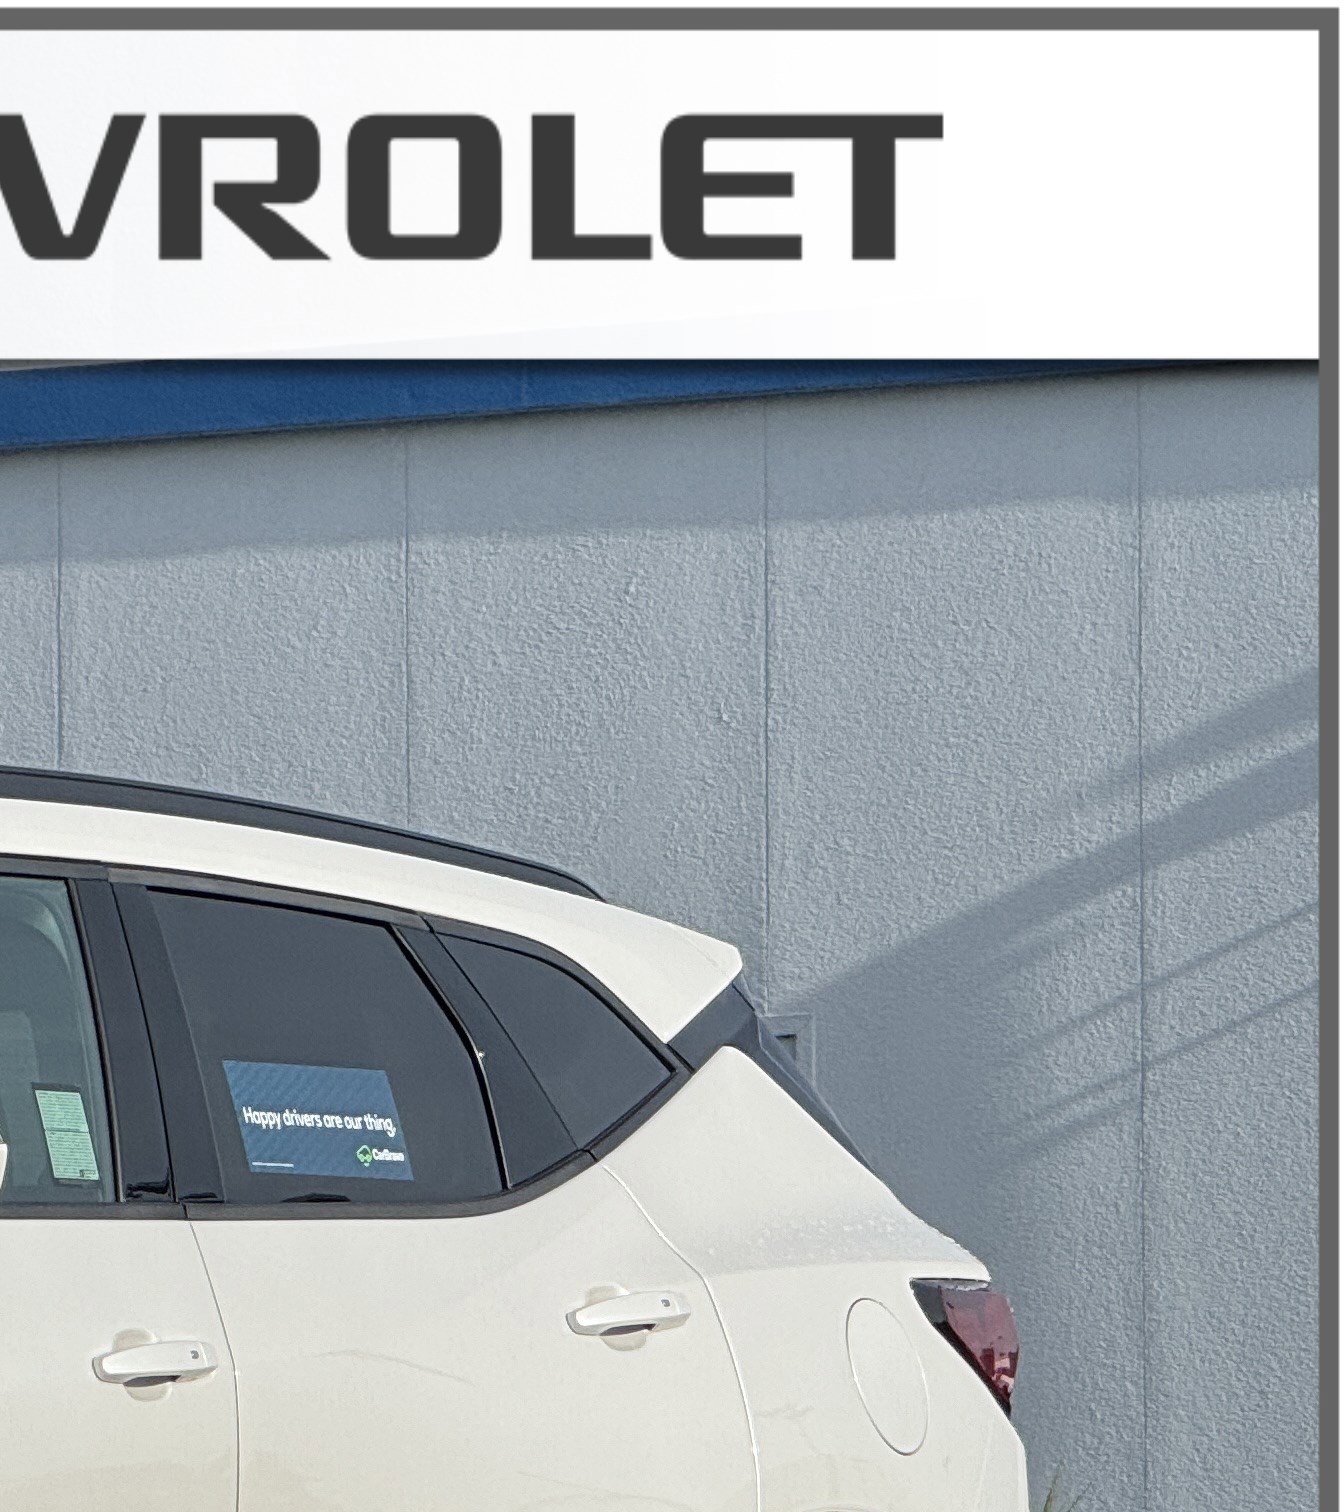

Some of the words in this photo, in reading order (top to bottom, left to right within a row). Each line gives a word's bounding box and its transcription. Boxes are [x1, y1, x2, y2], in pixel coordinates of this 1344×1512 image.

[242, 1106, 281, 1130] Happy
[282, 1109, 323, 1127] drivers
[323, 1115, 343, 1129] are
[344, 1116, 363, 1130] our
[364, 1113, 397, 1138] thing.
